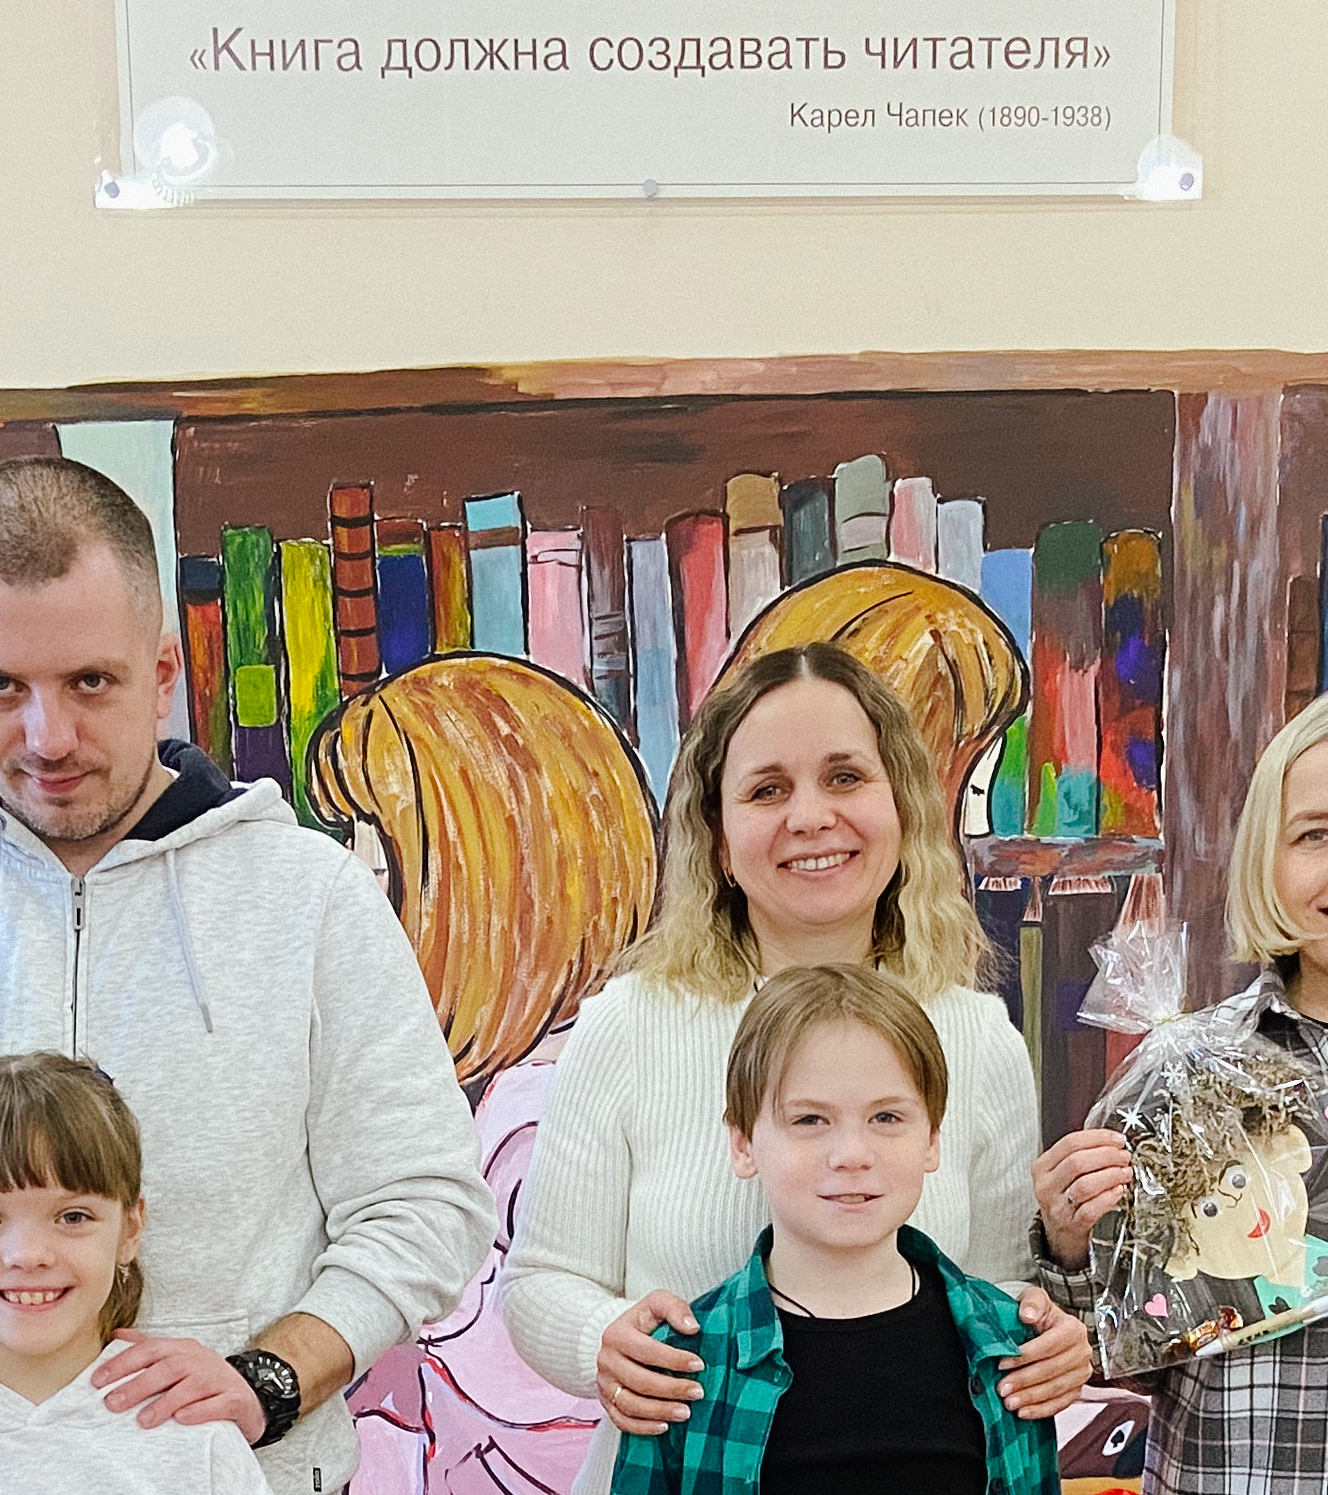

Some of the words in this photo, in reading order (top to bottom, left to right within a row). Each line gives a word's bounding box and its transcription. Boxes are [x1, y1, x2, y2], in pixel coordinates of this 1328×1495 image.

[190, 27, 363, 72] «Книга
[380, 37, 570, 79] должна
[588, 36, 846, 78] создавать
[864, 36, 1111, 71] читателя»
[790, 102, 876, 134] Карел
[886, 102, 969, 128] Чапек
[978, 105, 1112, 132] (1890-1938)
